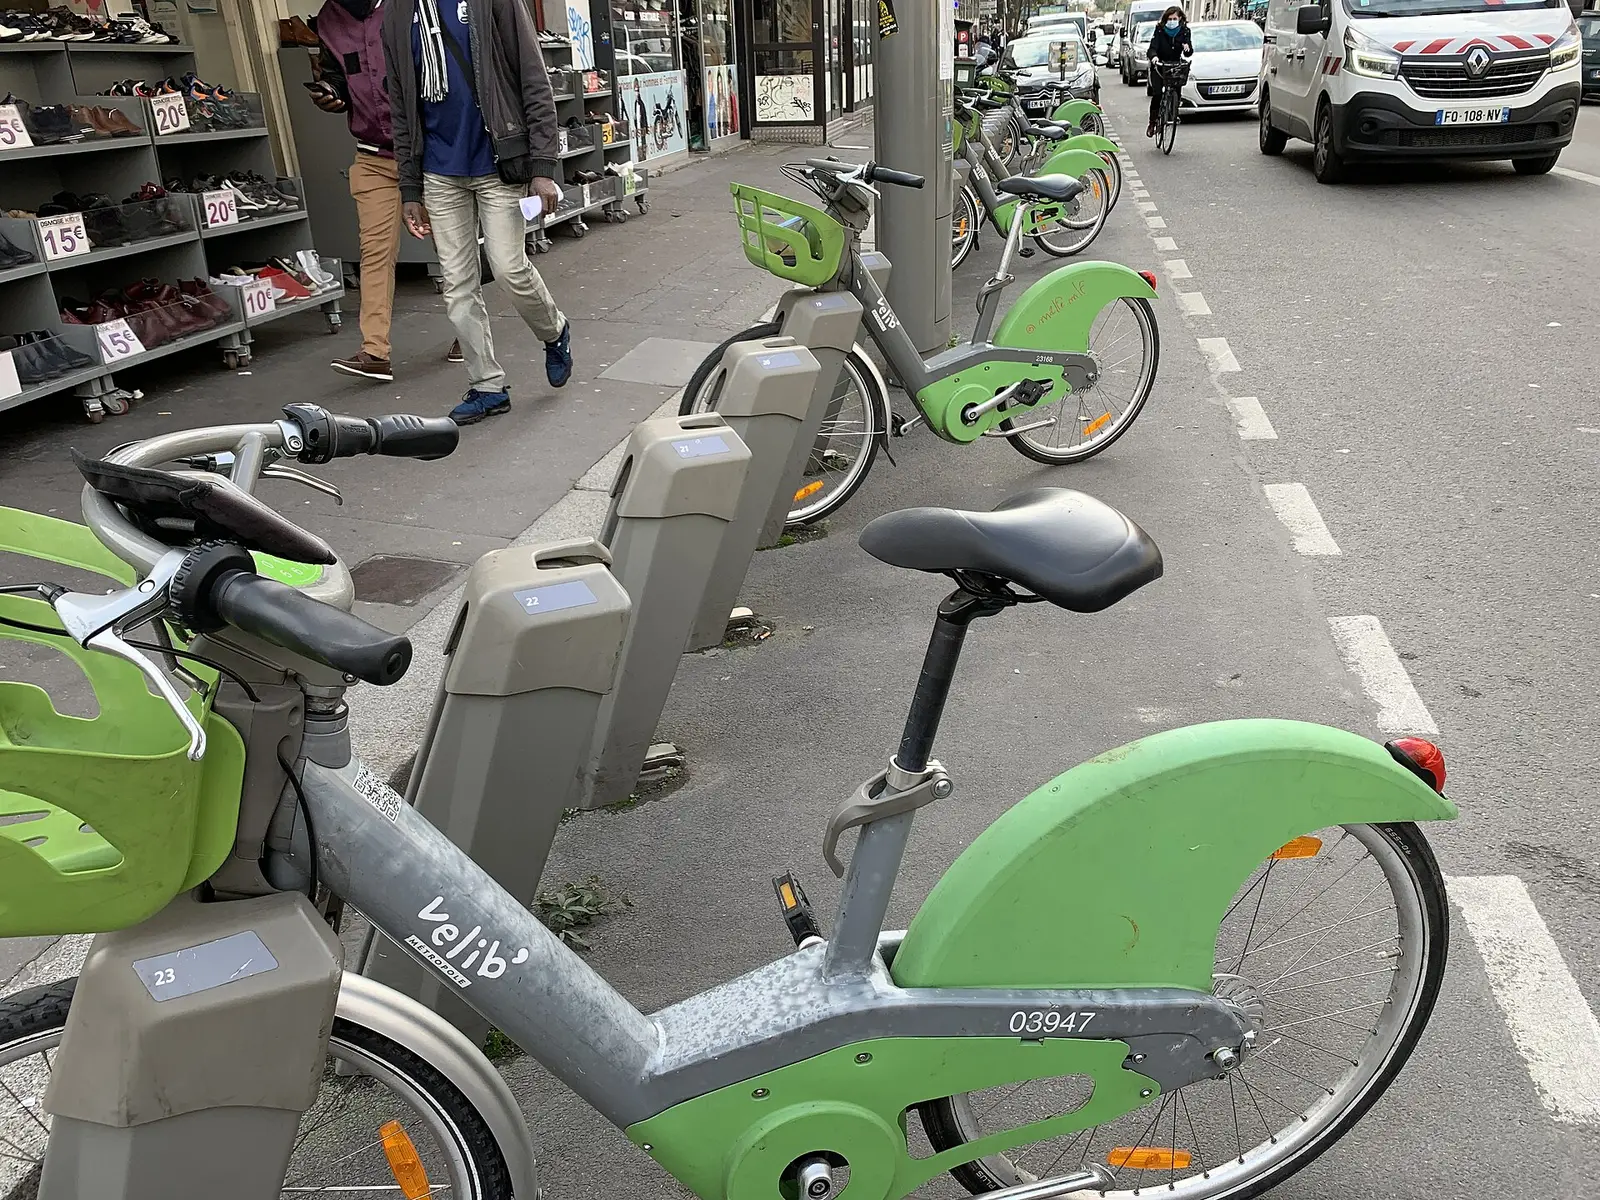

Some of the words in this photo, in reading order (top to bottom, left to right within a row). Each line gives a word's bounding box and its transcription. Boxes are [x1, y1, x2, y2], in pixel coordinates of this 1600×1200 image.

[156, 103, 185, 131] 20€
[208, 199, 235, 225] 20€
[44, 225, 84, 255] 15€
[247, 288, 272, 313] 10€
[99, 329, 135, 359] 15€
[679, 445, 689, 453] 21
[526, 595, 540, 607] 22
[154, 967, 176, 986] 23
[1008, 1011, 1096, 1033] 03947
[976, 1170, 997, 1190] PLUS
